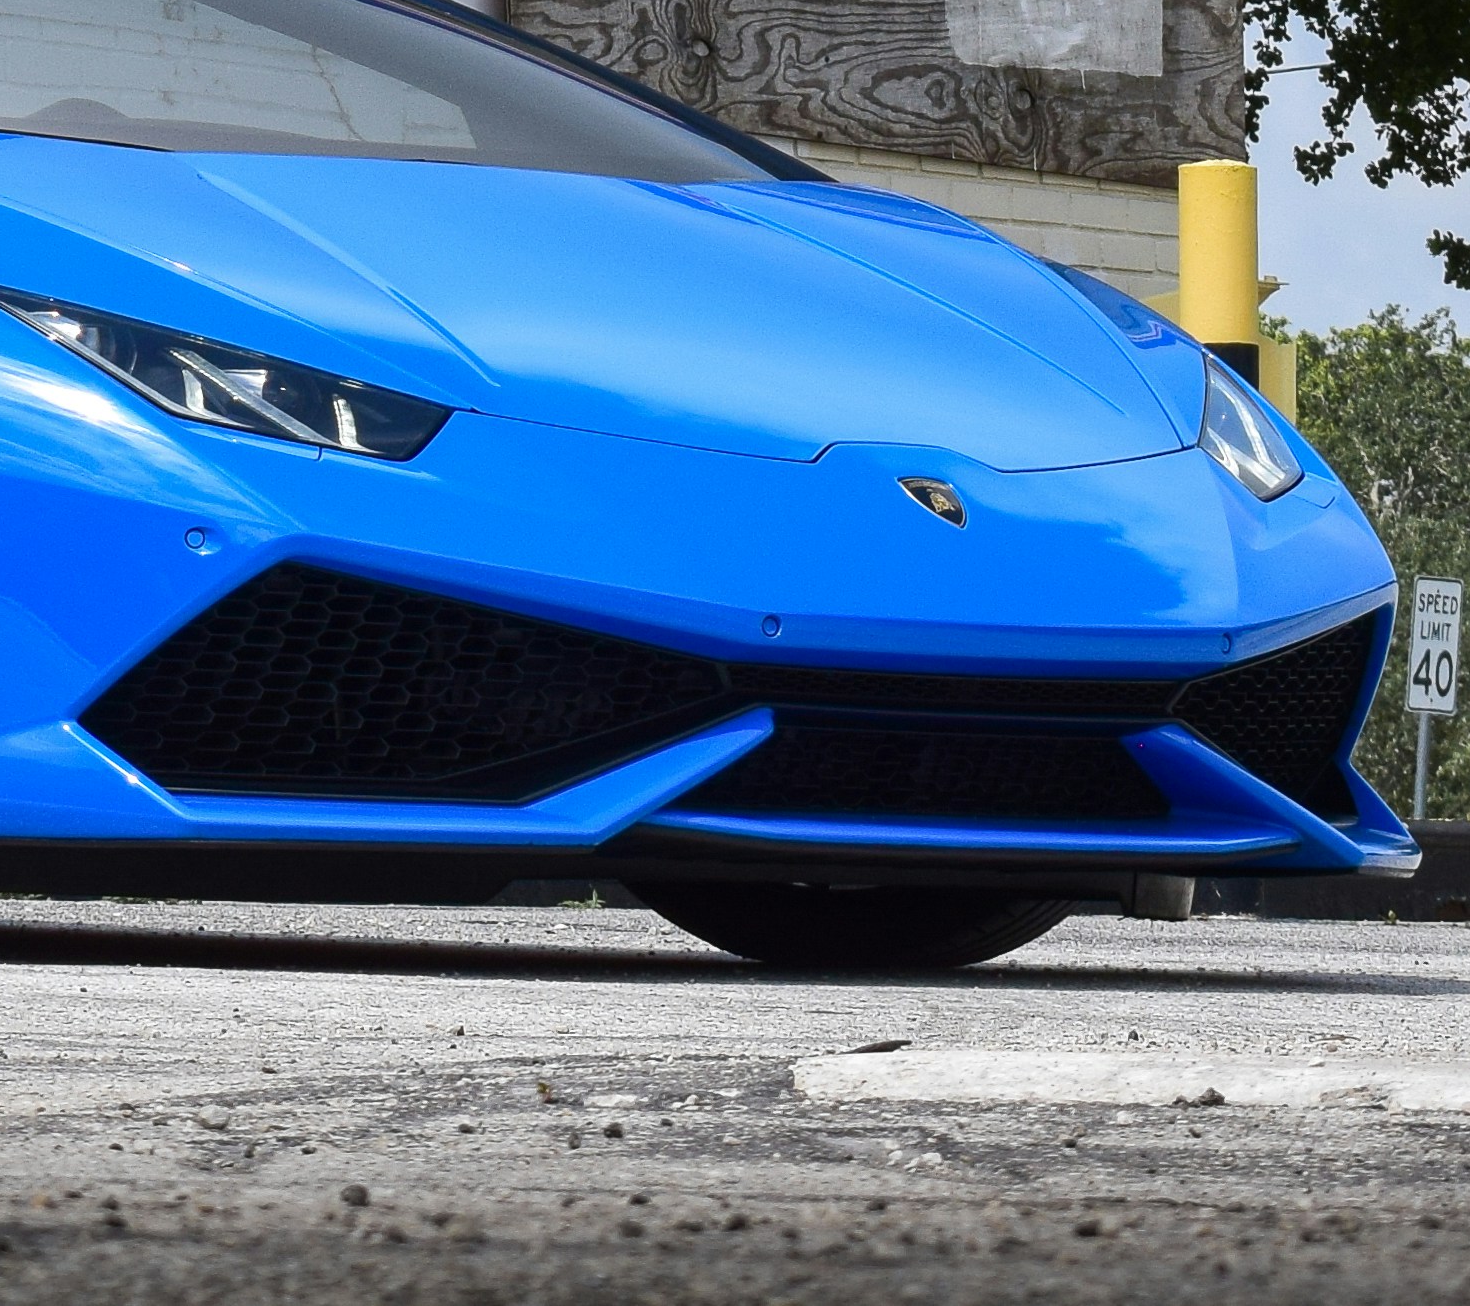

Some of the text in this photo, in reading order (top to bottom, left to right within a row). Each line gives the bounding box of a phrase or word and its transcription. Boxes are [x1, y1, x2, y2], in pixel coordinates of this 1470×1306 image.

[1418, 592, 1458, 615] SPEED
[1420, 620, 1452, 642] LIMIT
[1413, 648, 1453, 698] 40
